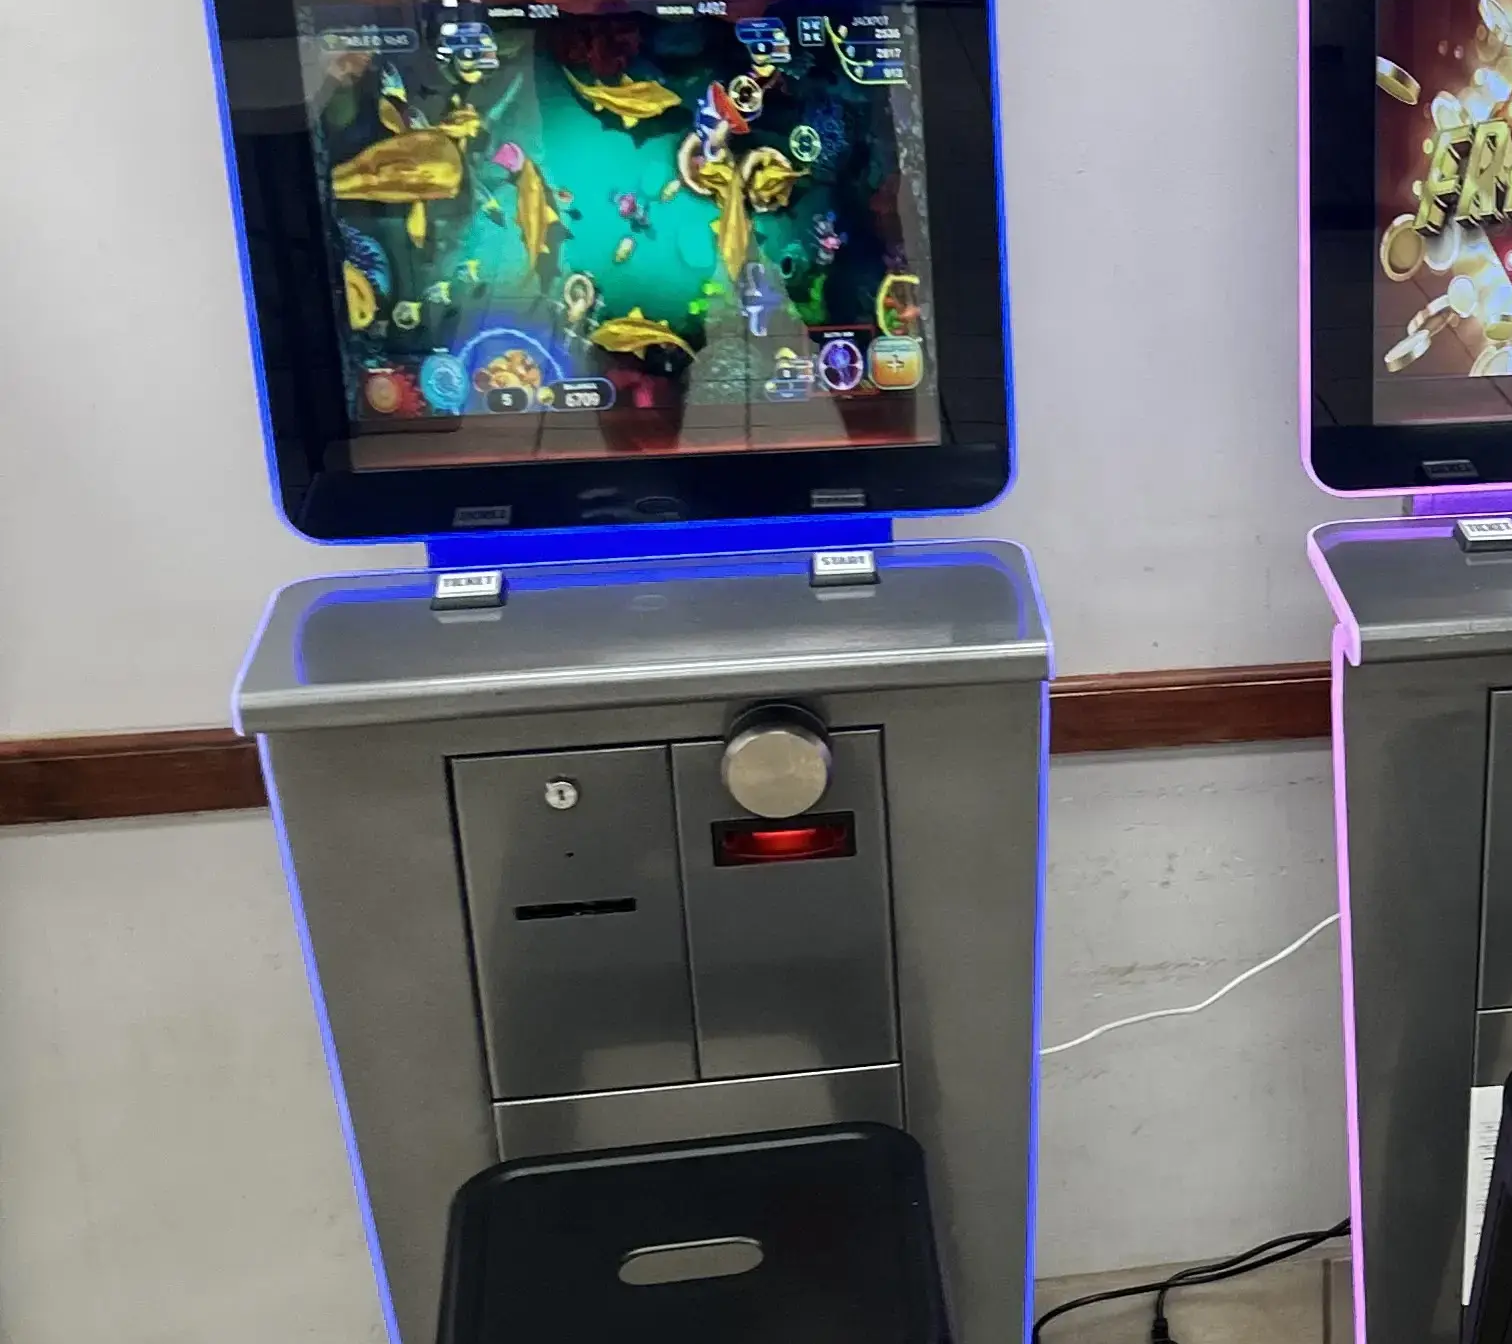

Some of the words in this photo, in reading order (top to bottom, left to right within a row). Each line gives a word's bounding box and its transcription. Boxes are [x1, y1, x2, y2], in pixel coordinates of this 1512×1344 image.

[852, 15, 889, 26] JACKPOT
[502, 394, 512, 406] 5
[821, 556, 865, 566] START
